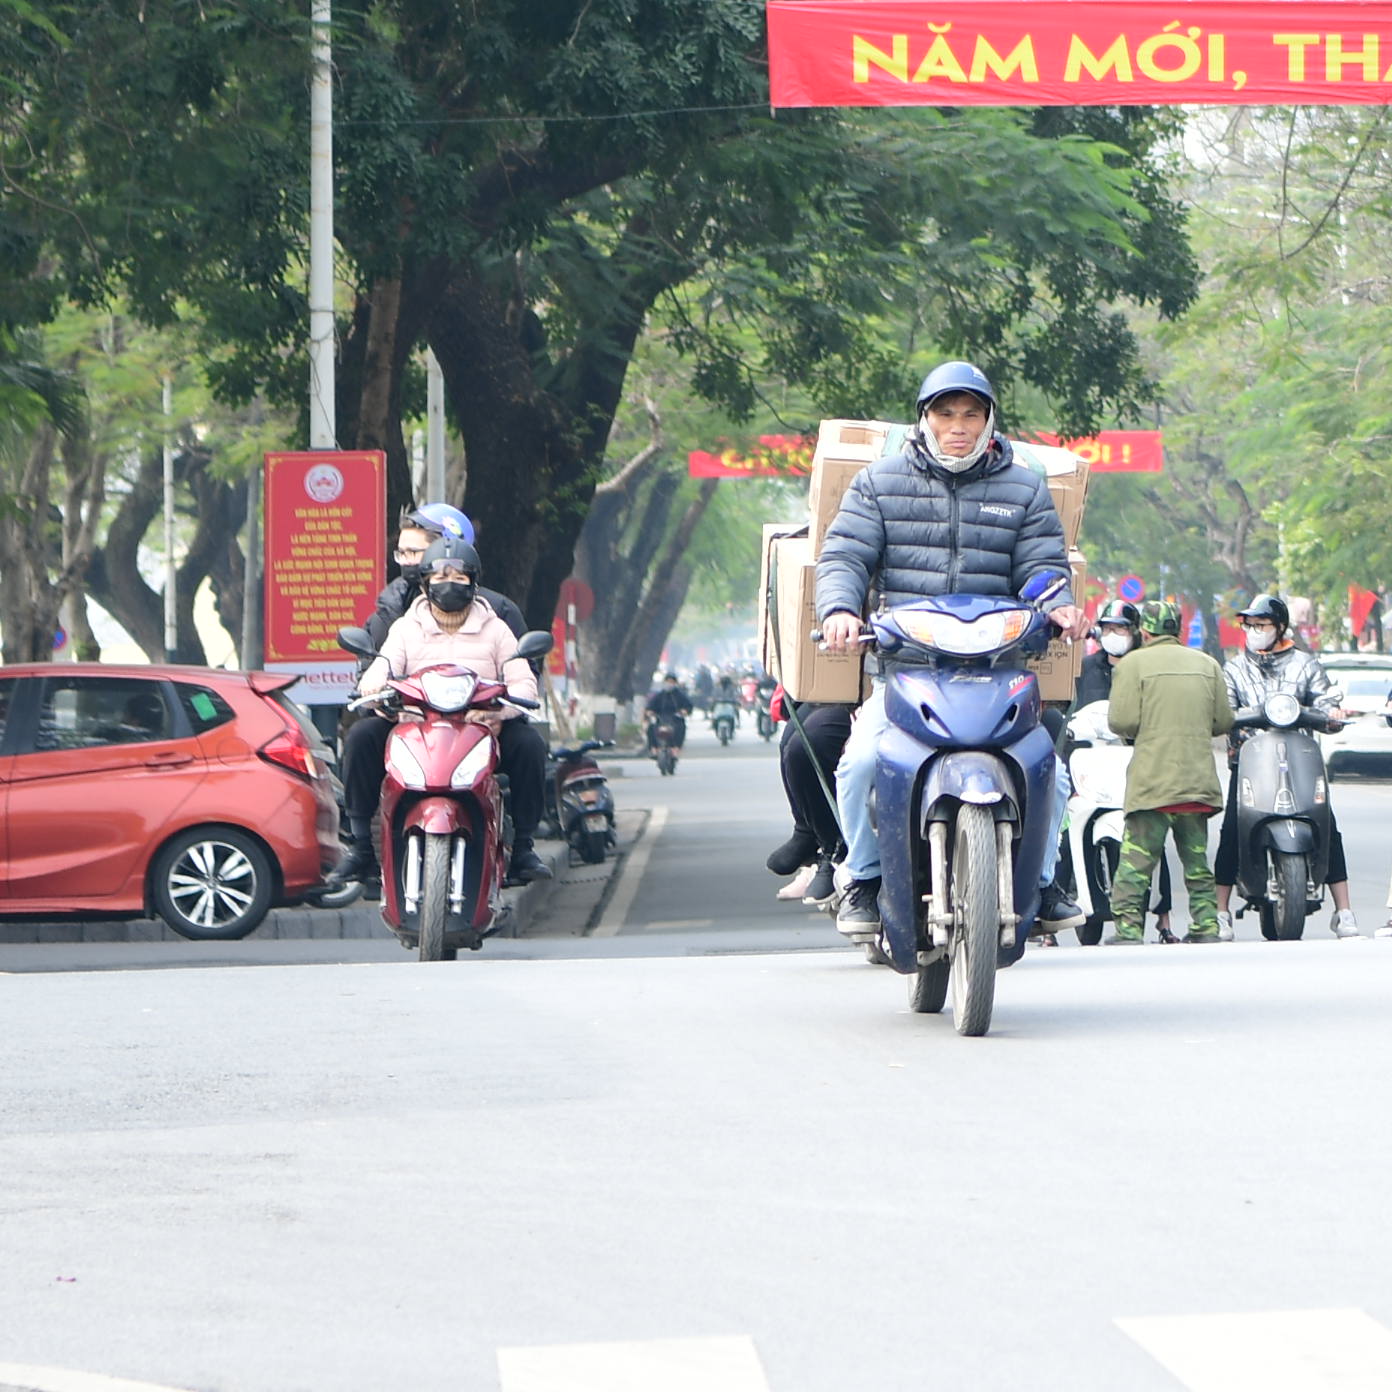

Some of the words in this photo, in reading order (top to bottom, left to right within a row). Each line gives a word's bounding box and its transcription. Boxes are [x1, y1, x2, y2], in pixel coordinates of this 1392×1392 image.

[851, 20, 1041, 85] NĂM
[1063, 18, 1249, 91] MỚI,
[304, 670, 356, 684] iettel
